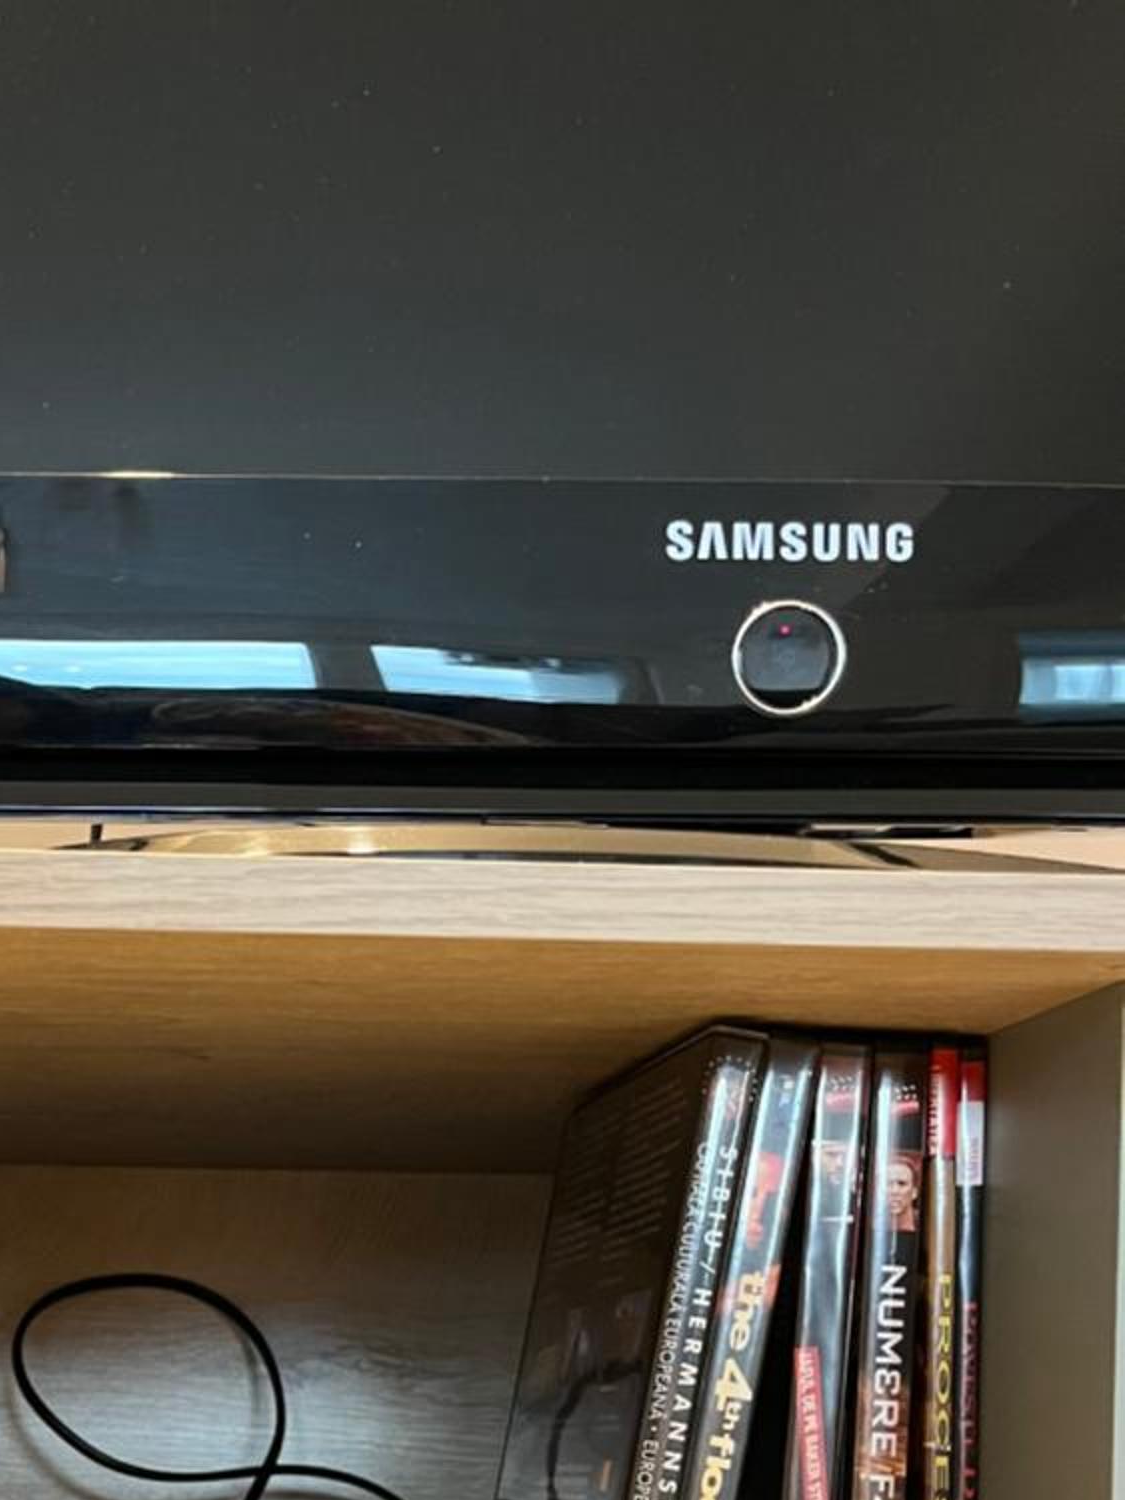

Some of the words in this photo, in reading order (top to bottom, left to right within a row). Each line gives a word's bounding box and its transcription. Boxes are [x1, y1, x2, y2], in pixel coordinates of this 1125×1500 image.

[665, 519, 914, 562] SAMSUNG
[703, 1145, 739, 1248] SIBIU
[729, 1270, 766, 1350] the
